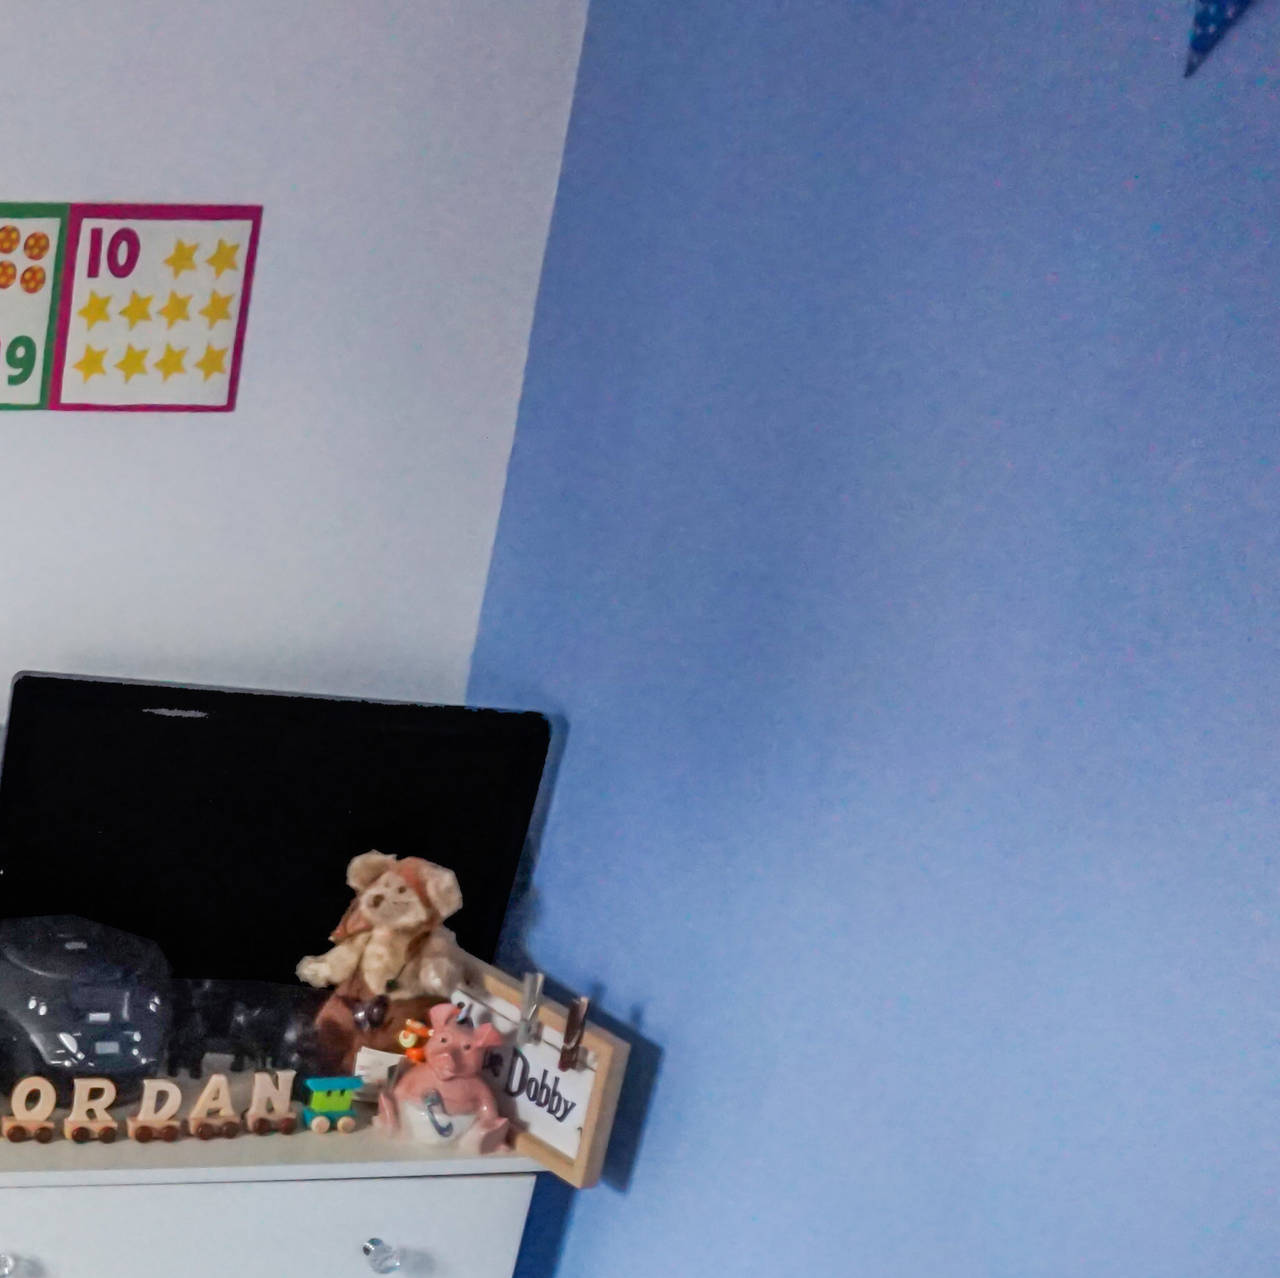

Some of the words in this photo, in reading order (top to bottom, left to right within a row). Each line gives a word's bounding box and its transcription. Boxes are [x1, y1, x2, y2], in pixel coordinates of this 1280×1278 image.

[86, 227, 141, 278] 10
[6, 335, 37, 386] 9
[504, 1047, 576, 1122] Dobby
